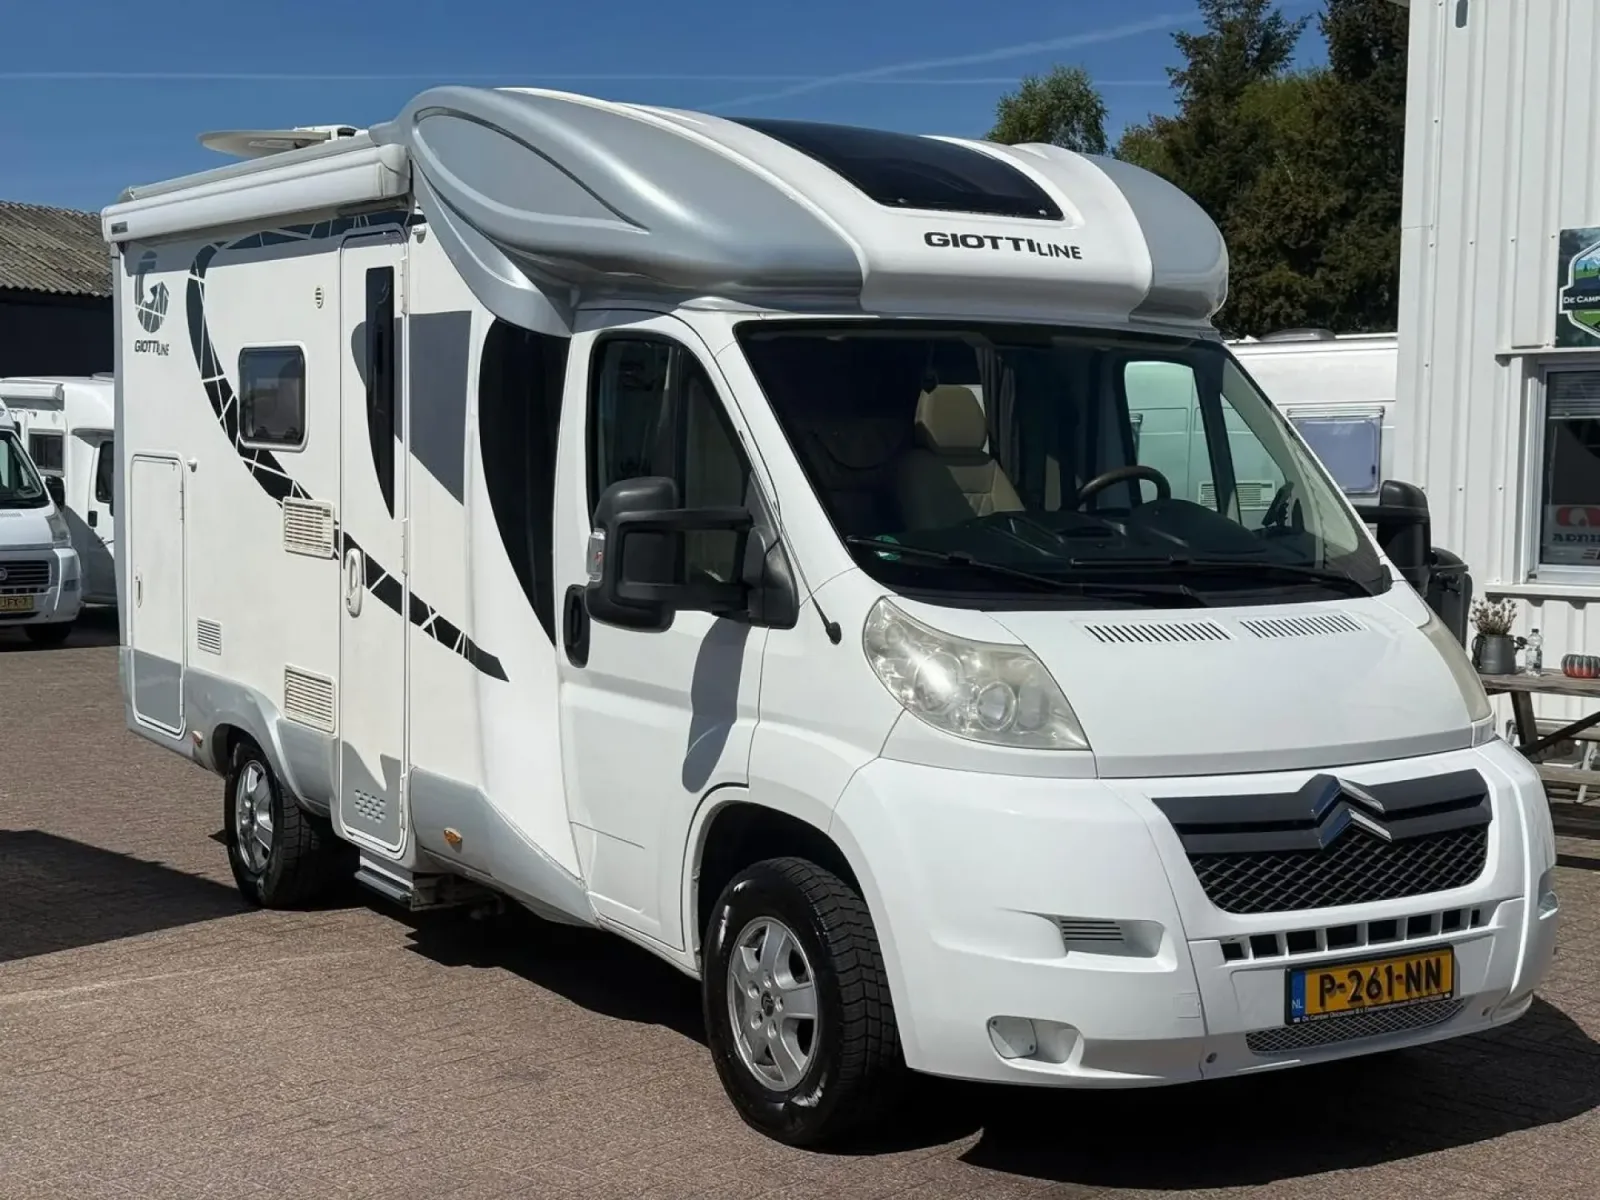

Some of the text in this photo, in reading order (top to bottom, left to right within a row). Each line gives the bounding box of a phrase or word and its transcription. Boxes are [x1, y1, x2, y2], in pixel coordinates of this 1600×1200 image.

[923, 231, 1083, 260] GIOTTILINE
[1319, 957, 1441, 1007] P-261-NN
[1291, 999, 1304, 1009] NL
